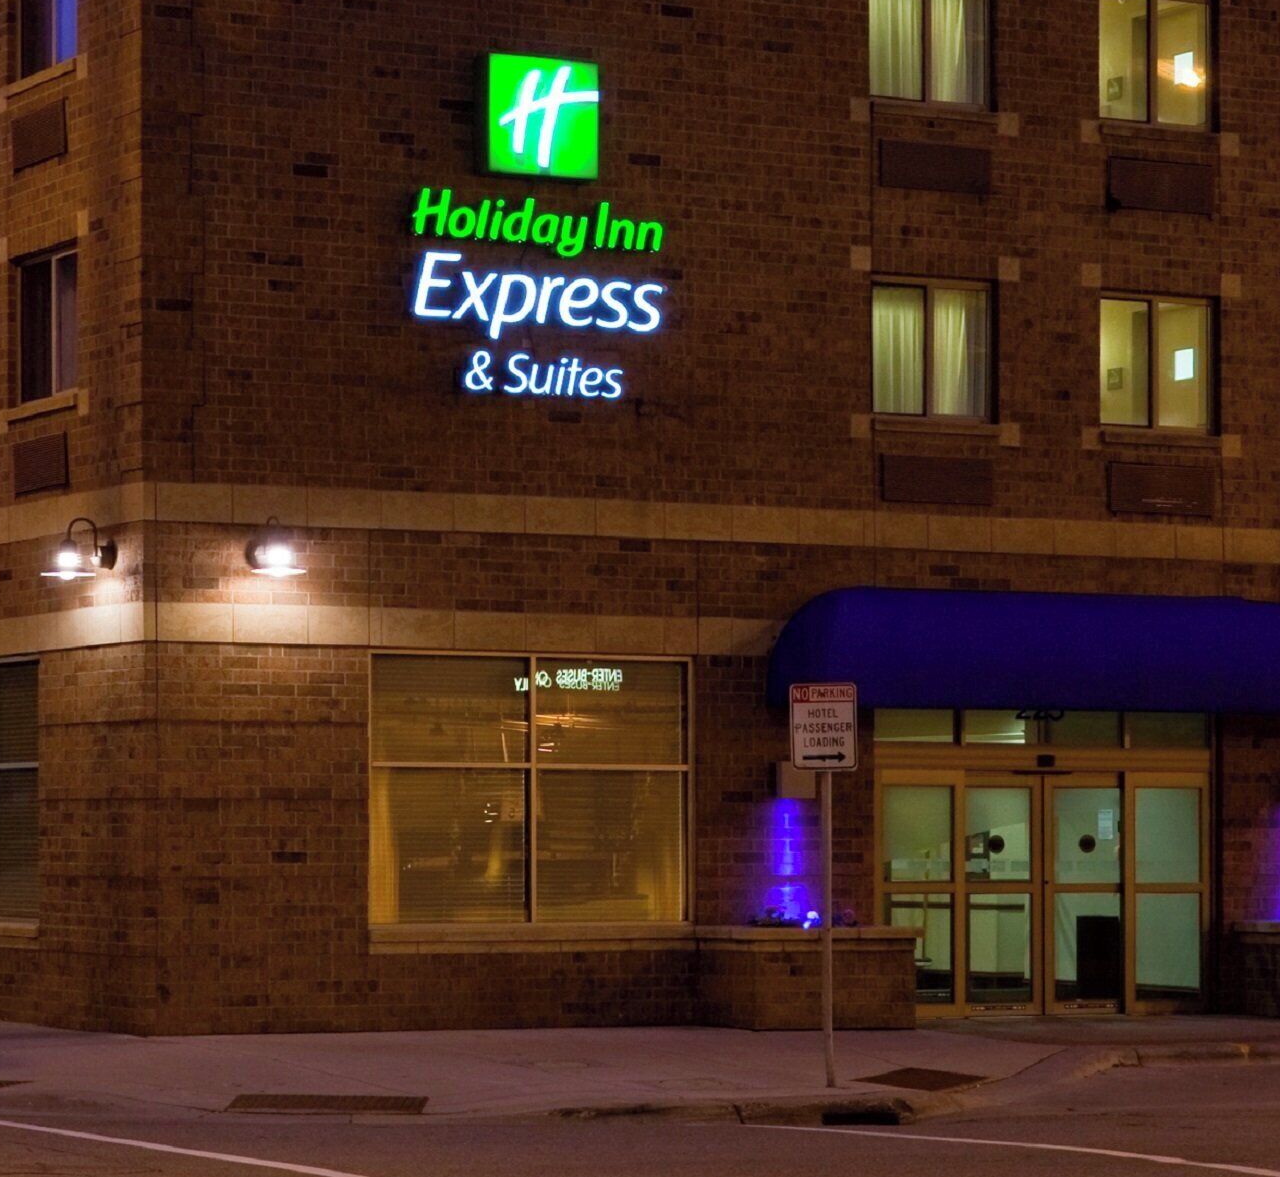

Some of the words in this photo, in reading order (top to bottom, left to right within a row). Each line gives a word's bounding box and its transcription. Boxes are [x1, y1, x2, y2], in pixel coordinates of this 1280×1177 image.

[412, 188, 588, 256] Holiday
[594, 202, 664, 252] Inn
[414, 251, 664, 340] Express
[464, 350, 494, 392] &
[503, 354, 624, 399] Suites
[793, 688, 809, 700] NO
[811, 688, 853, 699] PARKING
[808, 708, 839, 719] HOTEL
[794, 722, 853, 734] PASSENGER
[803, 736, 845, 748] LOADING
